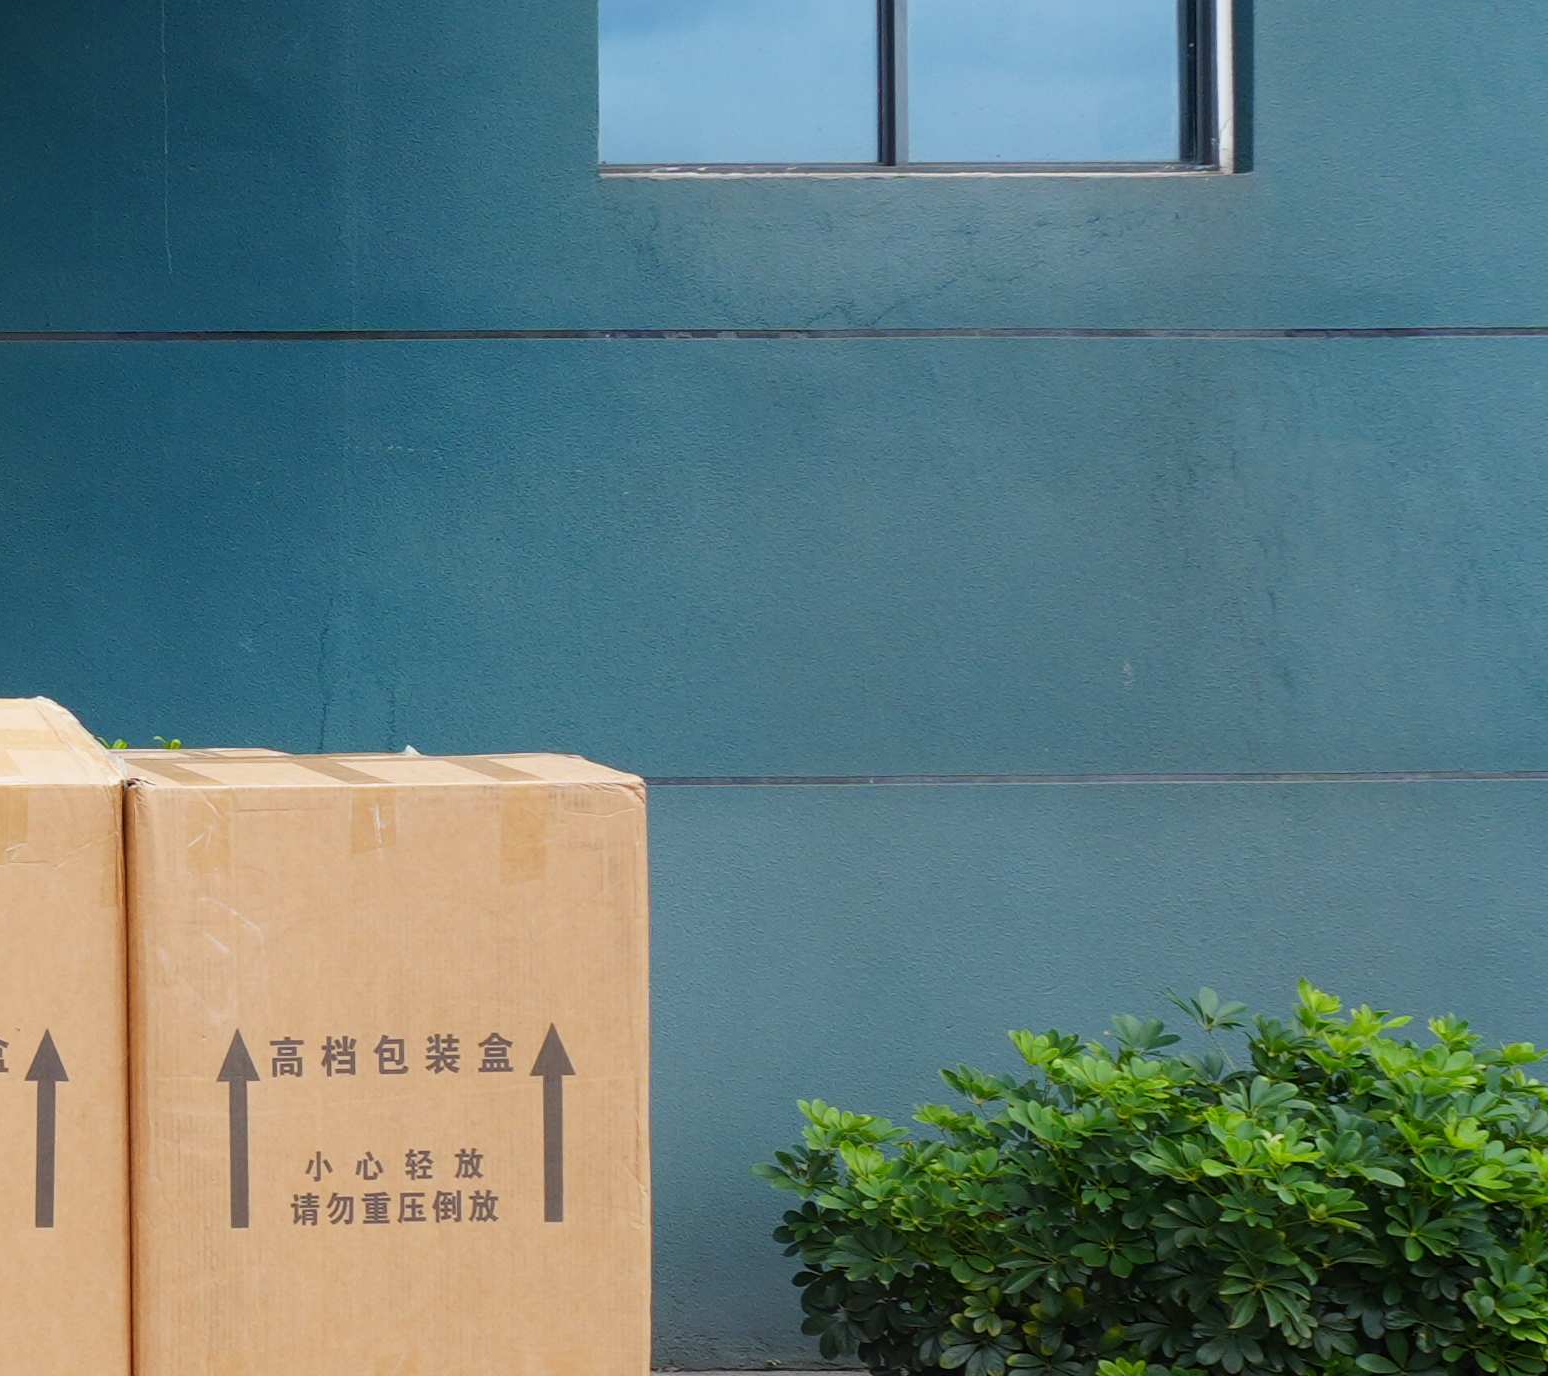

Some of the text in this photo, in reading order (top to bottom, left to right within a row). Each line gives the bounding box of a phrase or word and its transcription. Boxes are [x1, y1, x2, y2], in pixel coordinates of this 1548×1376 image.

[269, 1032, 514, 1078] 高档包装盒
[304, 1147, 484, 1182] 小心轻放
[289, 1190, 500, 1226] 请勿重压倒放
